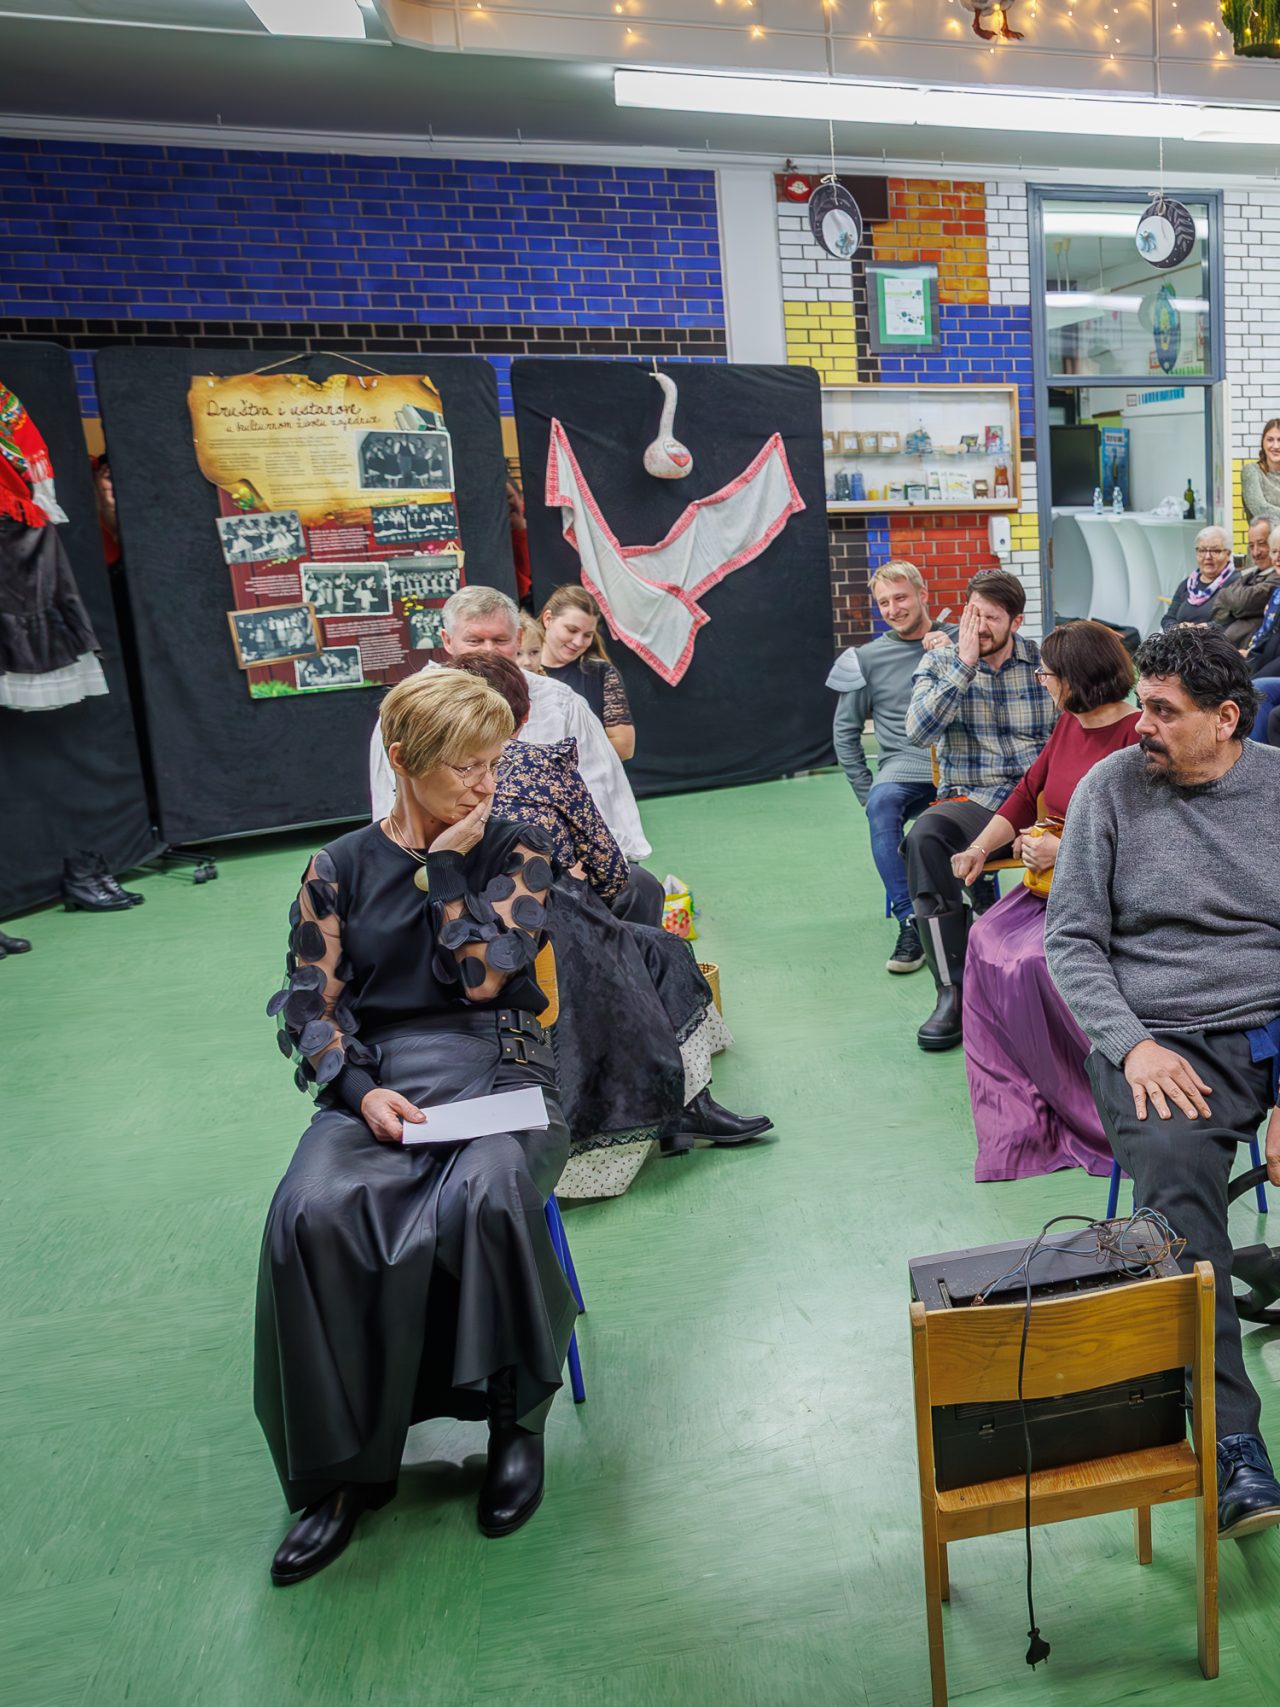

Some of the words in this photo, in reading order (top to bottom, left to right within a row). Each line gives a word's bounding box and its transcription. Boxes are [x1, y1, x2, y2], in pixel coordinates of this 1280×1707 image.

[207, 399, 273, 417] Društva
[278, 401, 286, 416] i
[290, 401, 361, 416] ustanove
[236, 419, 293, 432] kulturnom
